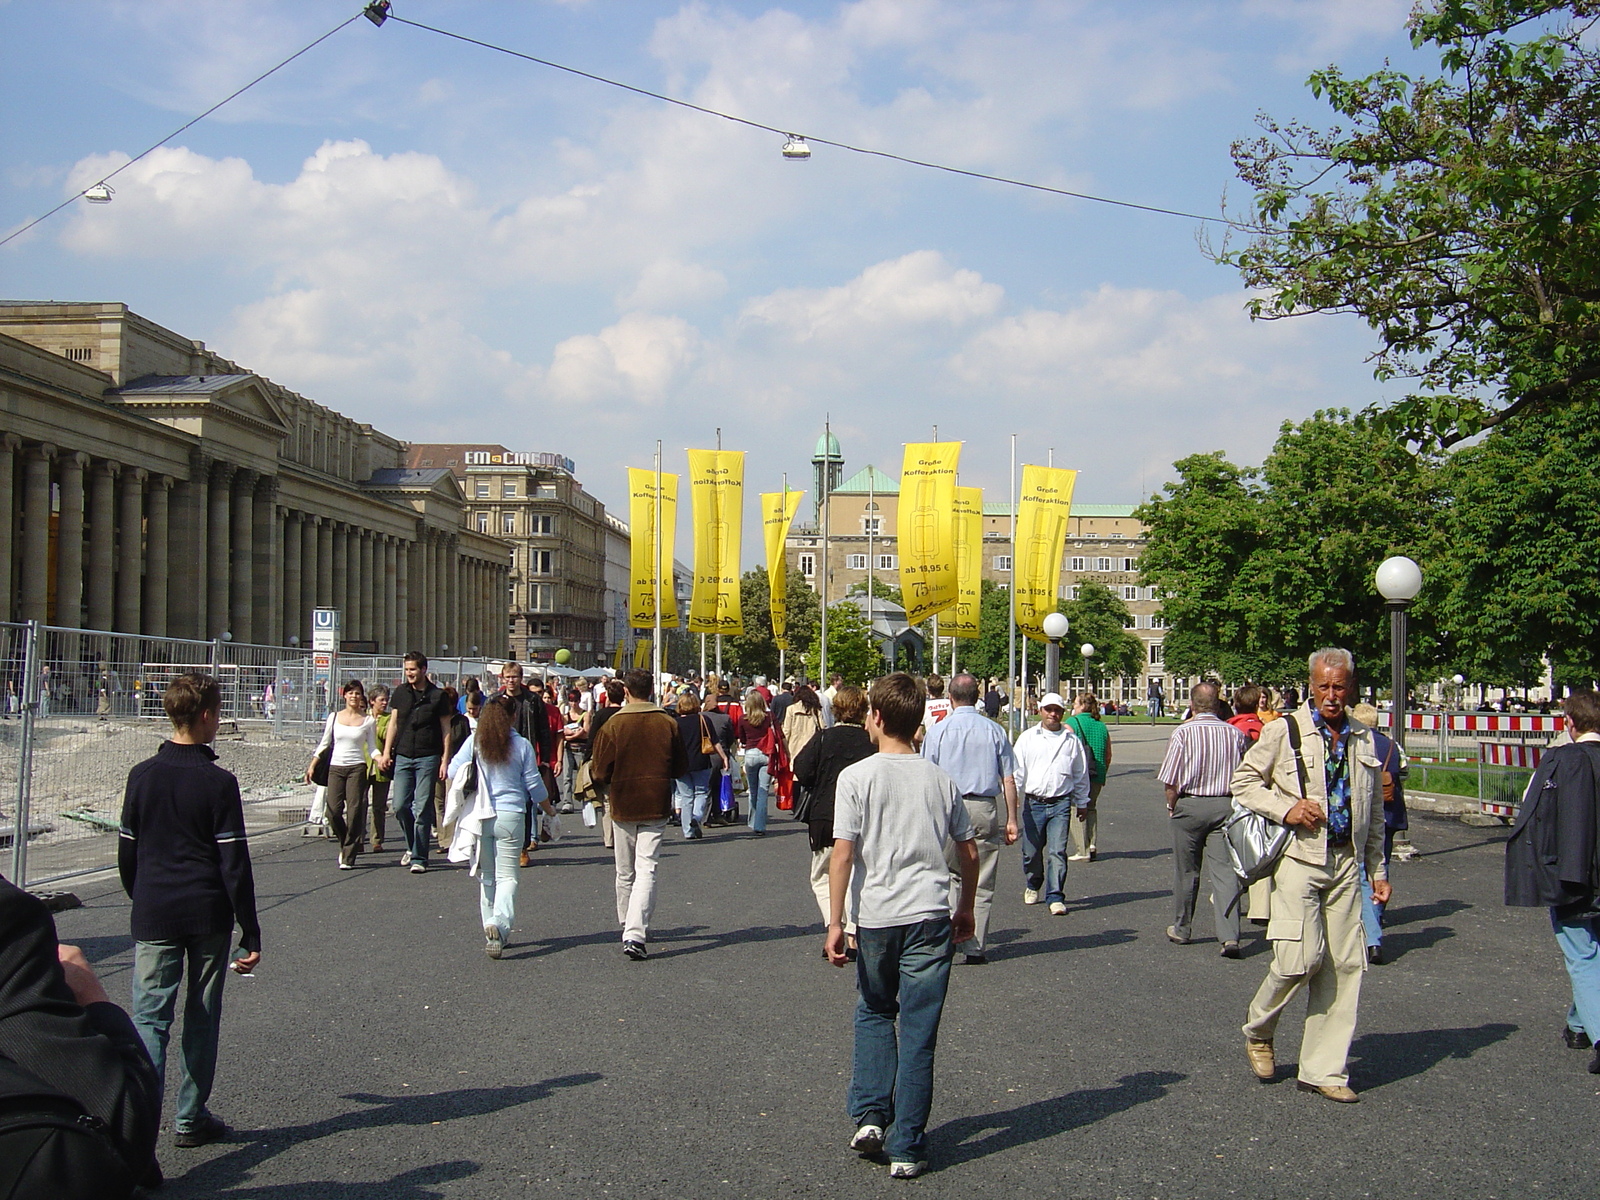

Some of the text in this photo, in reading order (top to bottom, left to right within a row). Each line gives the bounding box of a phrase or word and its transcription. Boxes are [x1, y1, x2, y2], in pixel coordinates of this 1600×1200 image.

[1023, 496, 1069, 506] Kofferaktion
[912, 582, 929, 598] 75
[1021, 602, 1036, 617] 75
[317, 612, 330, 626] U
